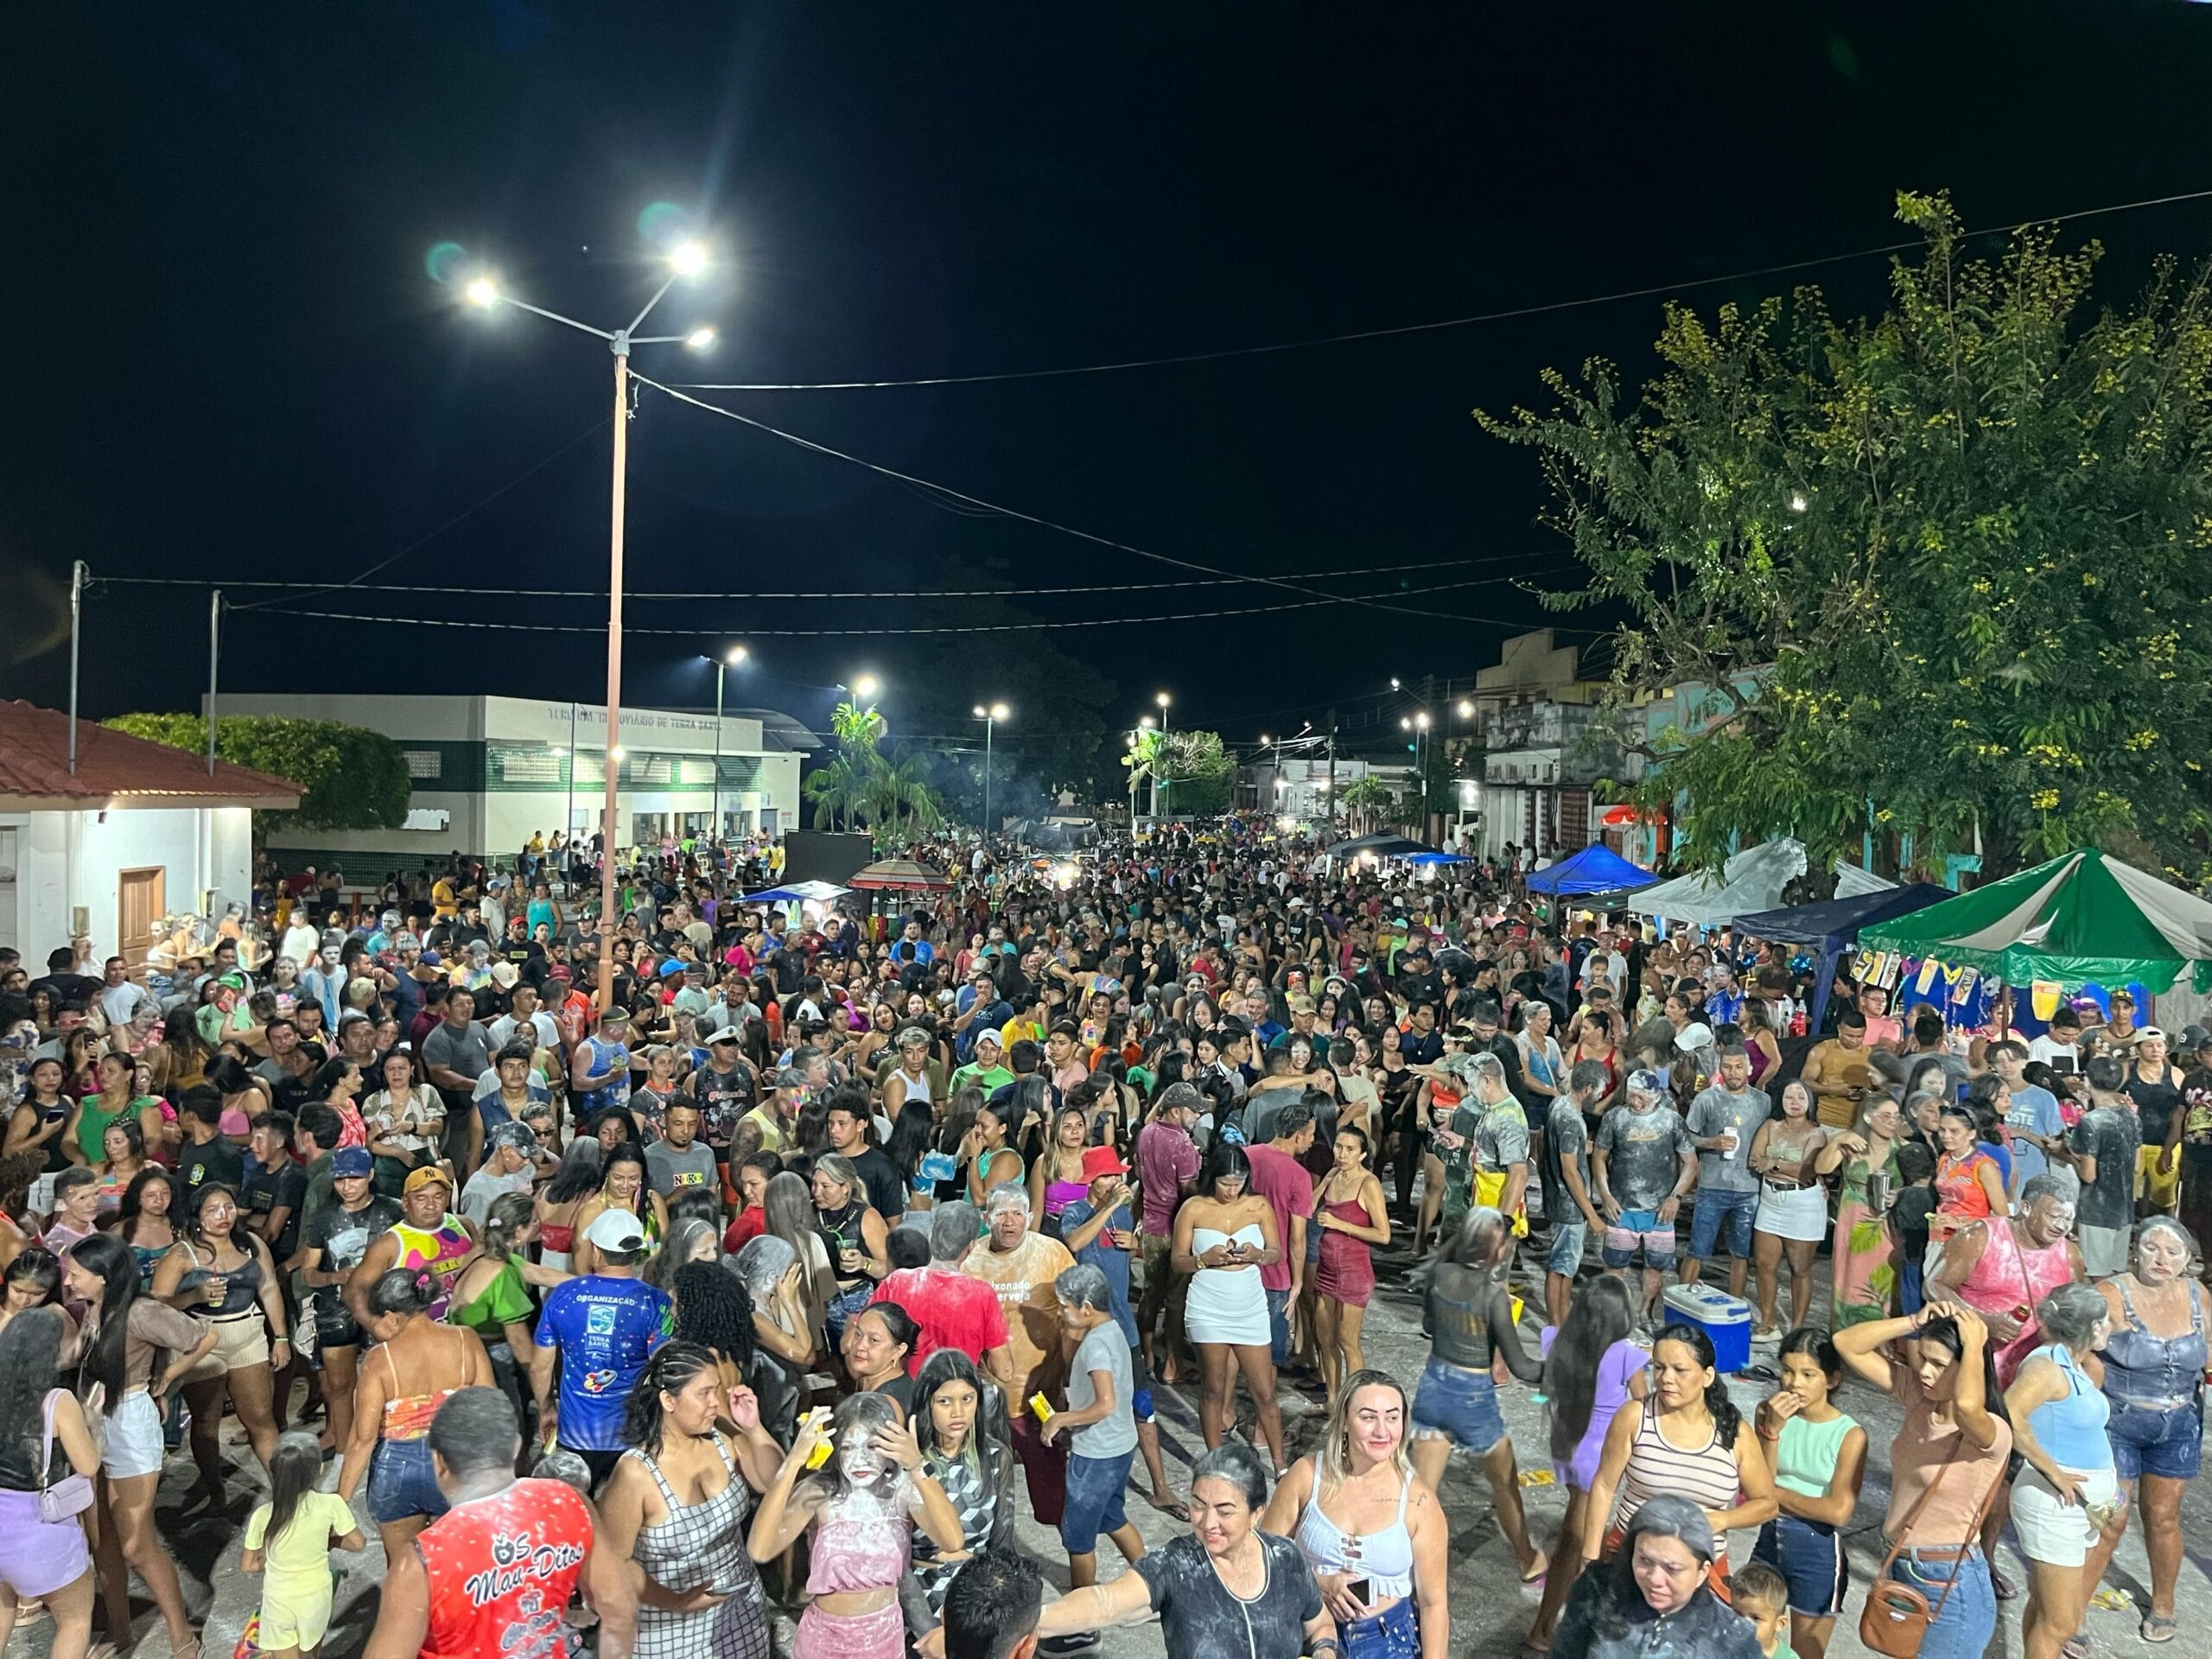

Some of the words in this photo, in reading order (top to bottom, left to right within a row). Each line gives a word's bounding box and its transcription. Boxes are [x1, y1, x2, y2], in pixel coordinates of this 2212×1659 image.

[657, 717, 668, 728] DE
[670, 718, 696, 729] TERRA
[673, 1173, 702, 1185] NIKE
[991, 1281, 1031, 1290] ixonado
[997, 1290, 1030, 1303] erveja
